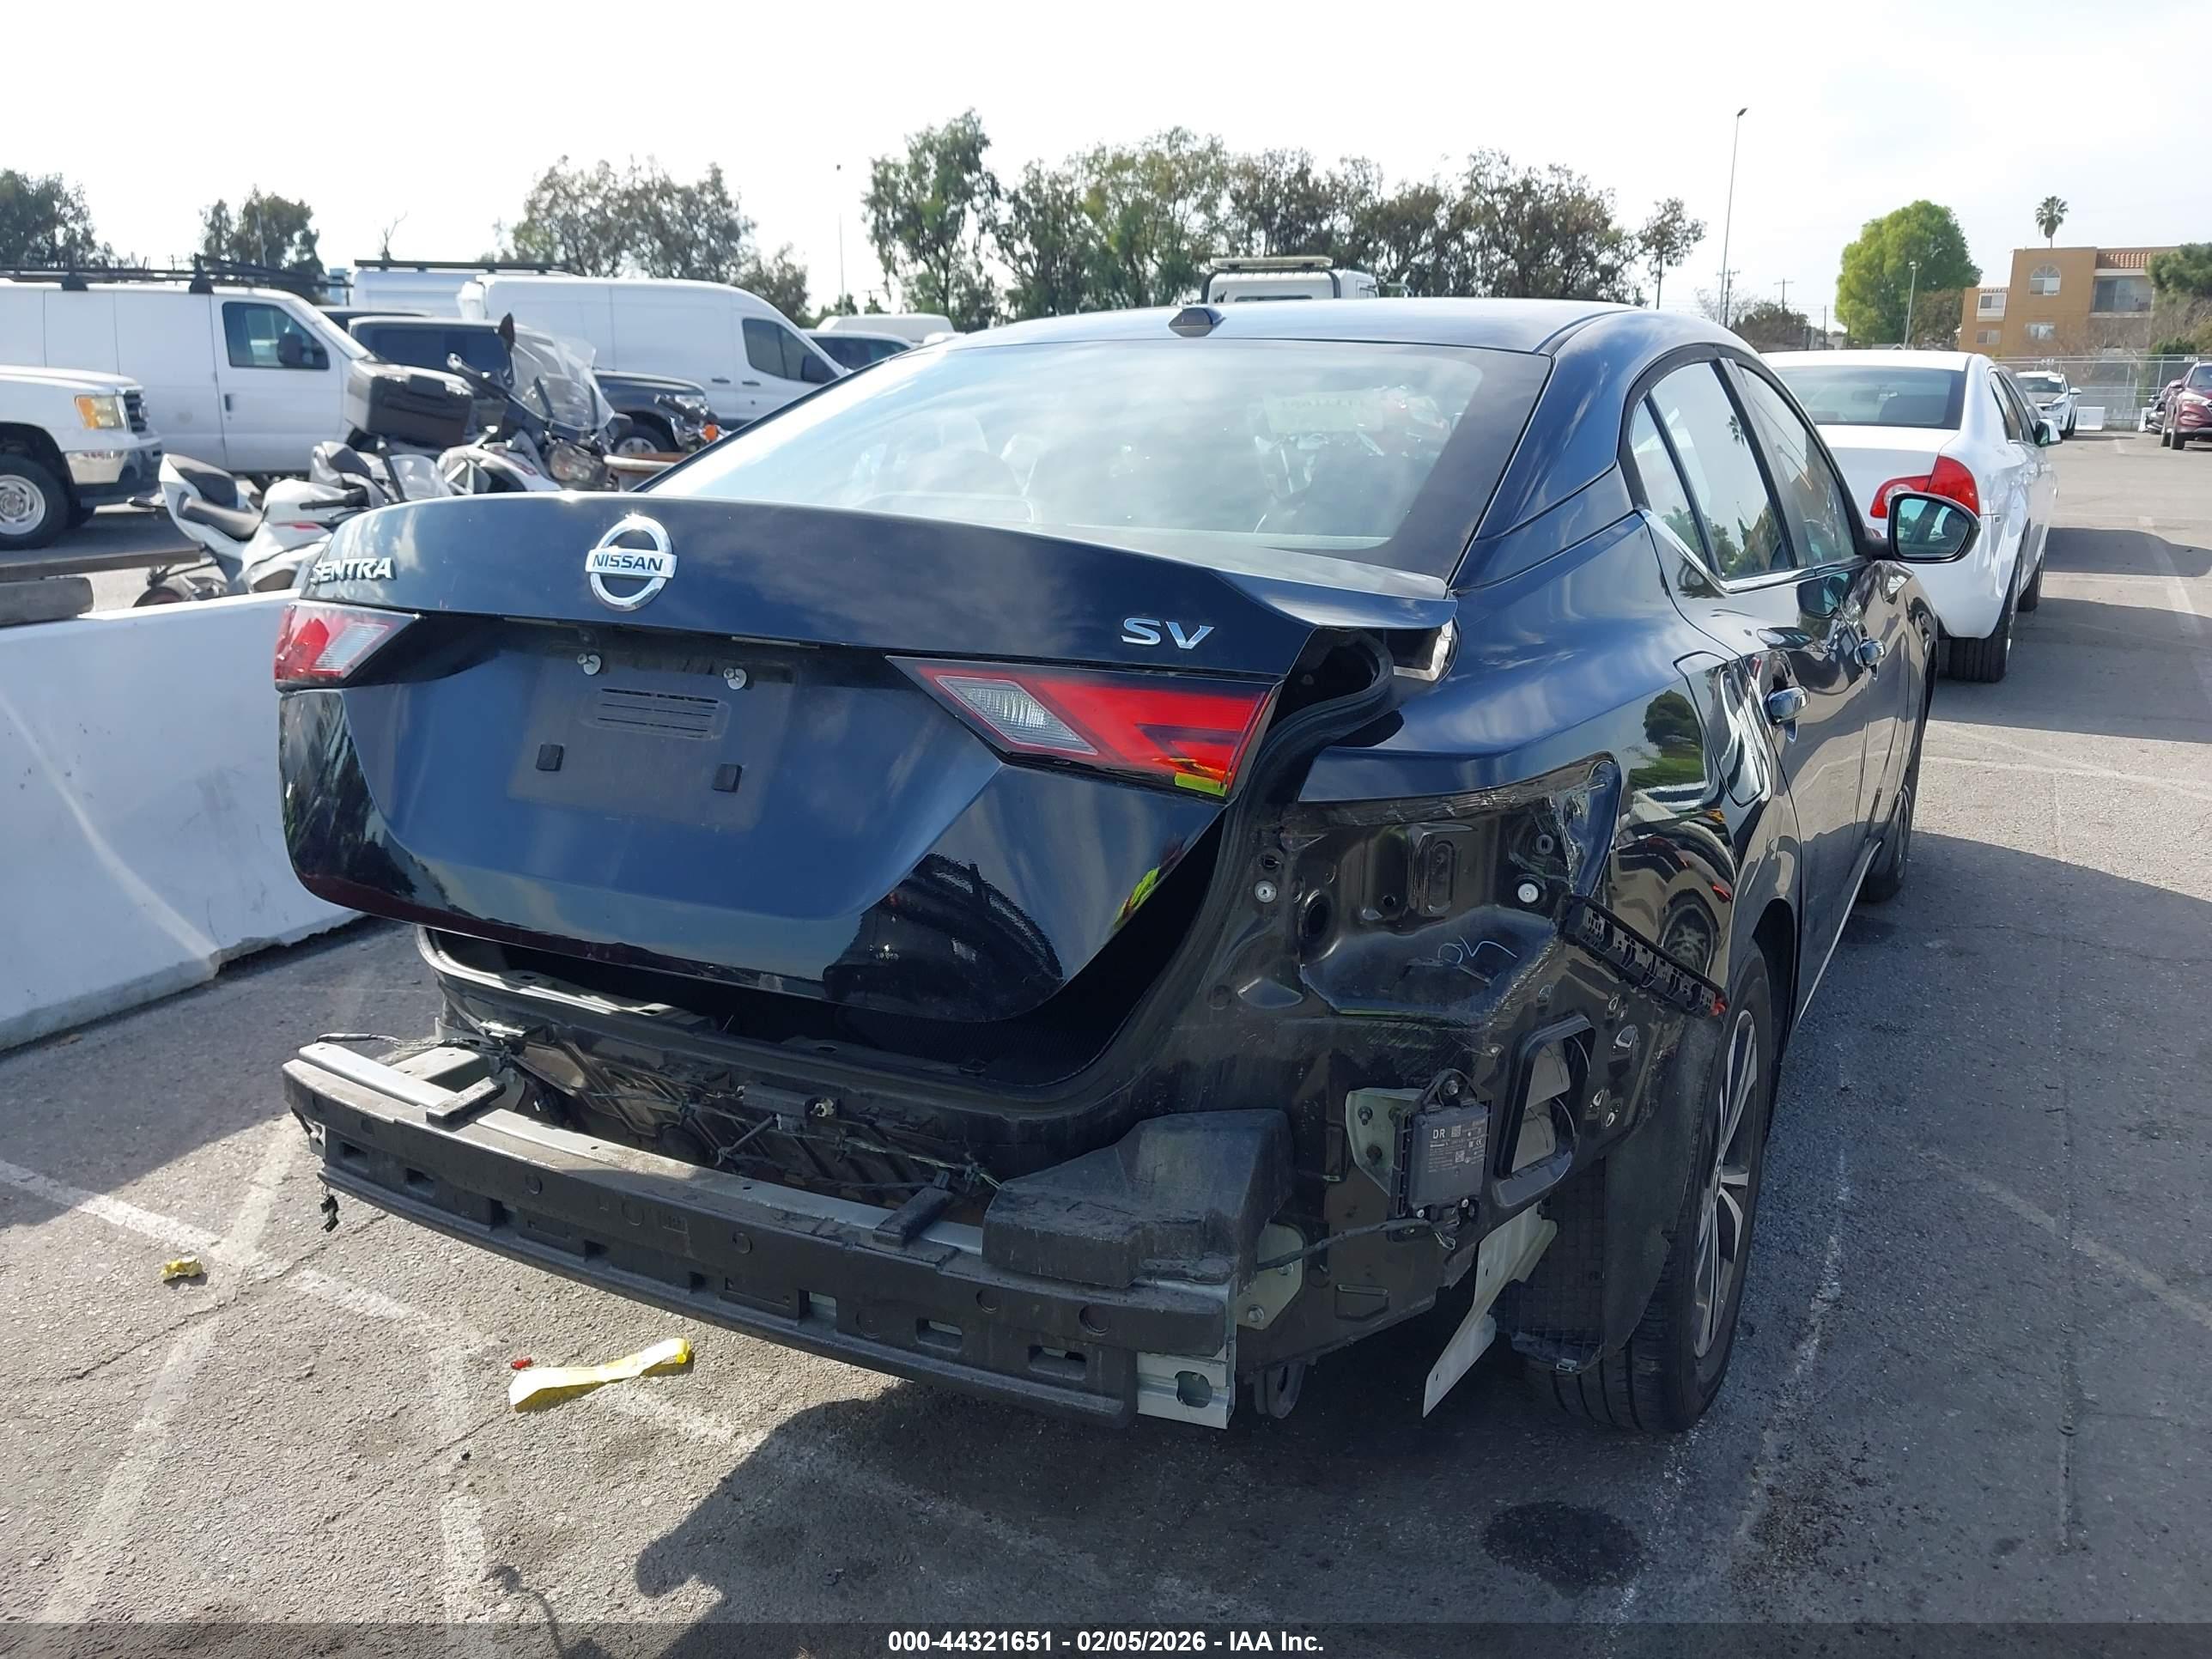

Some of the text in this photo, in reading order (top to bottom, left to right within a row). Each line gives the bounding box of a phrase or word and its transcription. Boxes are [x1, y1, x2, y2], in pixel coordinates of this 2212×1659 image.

[309, 556, 393, 585] SENTRA
[592, 554, 664, 572] NISSAN
[1121, 617, 1215, 650] SV
[1432, 1128, 1446, 1139] DR
